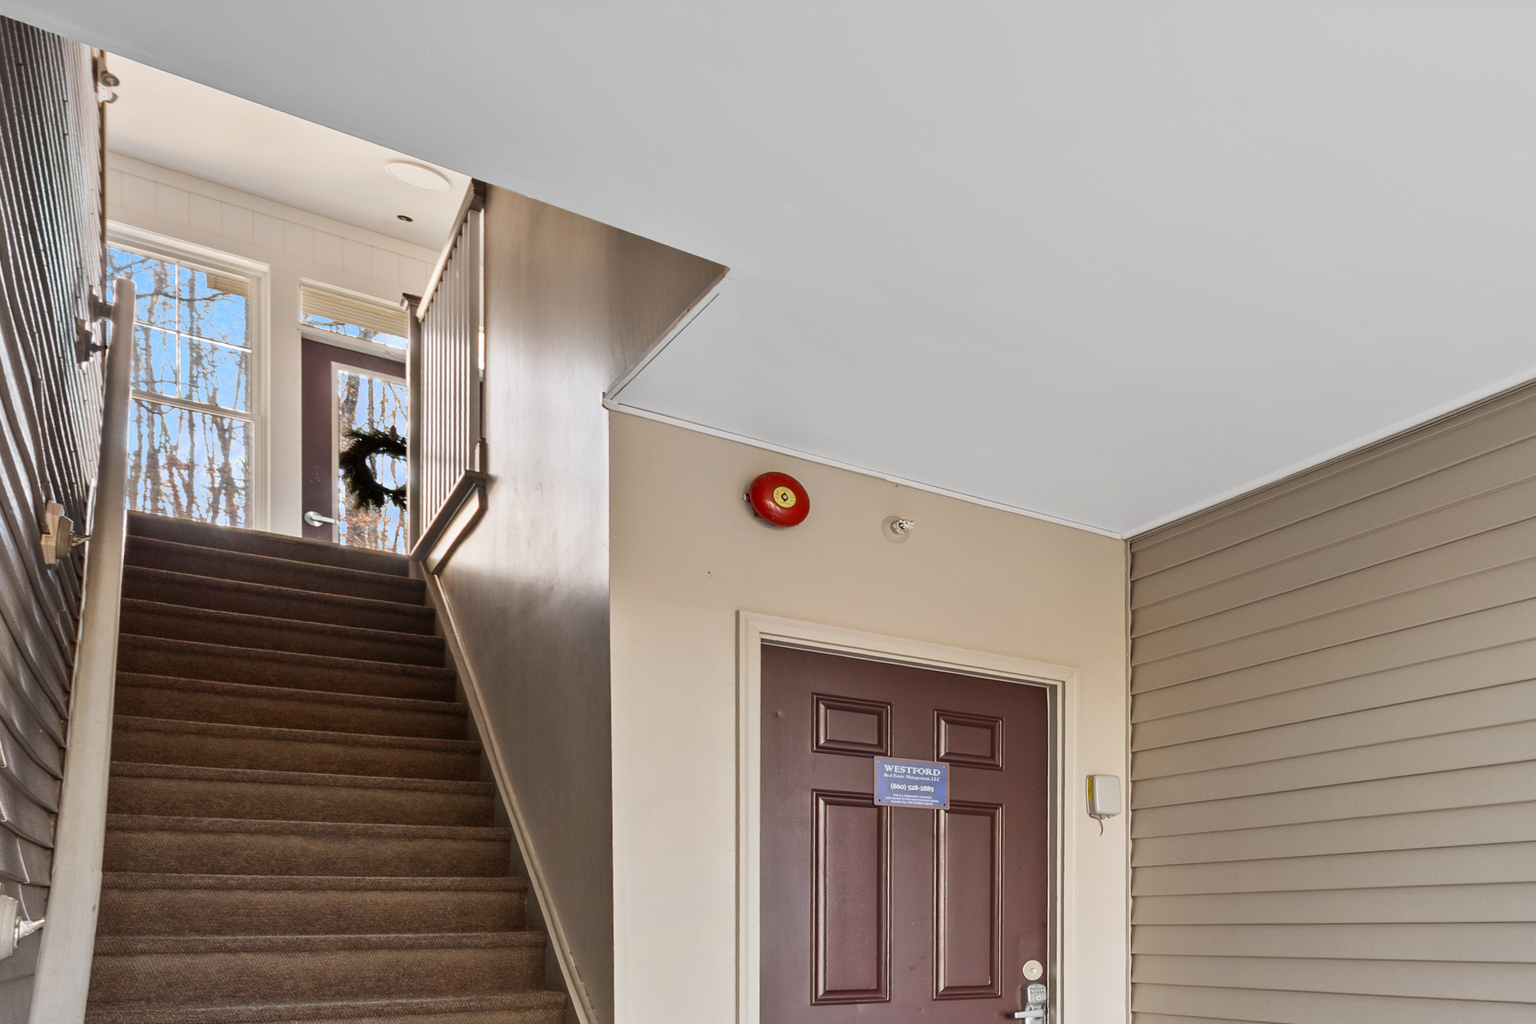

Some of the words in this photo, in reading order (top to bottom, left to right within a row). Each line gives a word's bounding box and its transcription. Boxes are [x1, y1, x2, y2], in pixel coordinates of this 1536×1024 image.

[884, 765, 941, 776] WESTFORD
[890, 783, 906, 791] (860)
[908, 784, 934, 793] 528-2885
